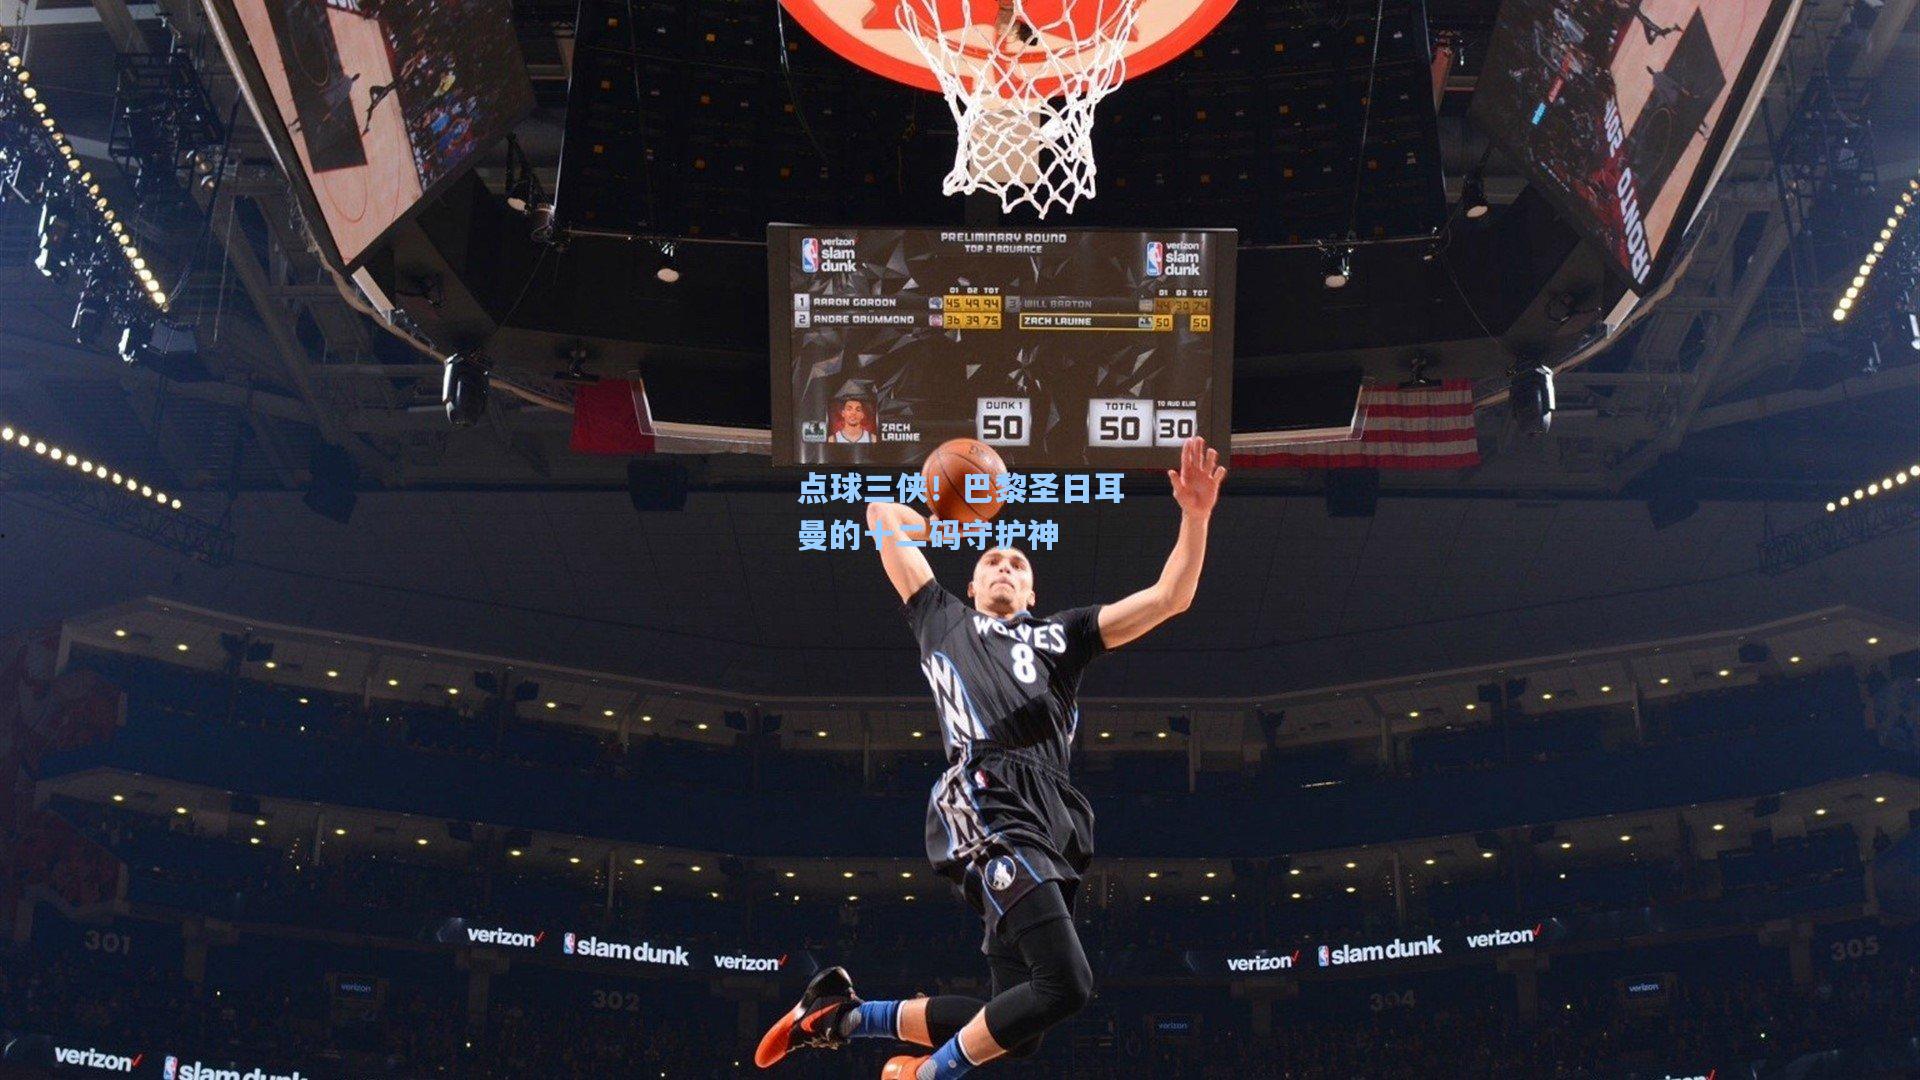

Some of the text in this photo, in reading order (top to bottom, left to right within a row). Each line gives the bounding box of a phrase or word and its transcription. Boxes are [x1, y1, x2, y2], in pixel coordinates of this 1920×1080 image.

[1617, 167, 1651, 285] RONTO
[821, 237, 855, 246] verizon
[940, 232, 1067, 243] PRELIMINARY ROUND
[821, 246, 855, 259] slam
[965, 244, 1043, 254] TOP 2 ADVANCE
[1166, 241, 1199, 250] verizon
[1165, 250, 1199, 263] slam
[821, 259, 857, 272] dunk
[1165, 263, 1200, 276] dunk
[813, 298, 850, 307] AARON
[852, 298, 897, 307] GORDON
[946, 298, 960, 308] 45
[965, 298, 980, 308] 49
[983, 298, 999, 308] 94
[1024, 300, 1048, 308] WILL
[1050, 300, 1092, 309] BARTON
[813, 315, 850, 323] ANDRE
[852, 315, 915, 324] DRUMMOND
[965, 315, 980, 325] 39
[983, 315, 999, 326] 75
[1024, 316, 1208, 328] ZACH LAVINE 50 50
[986, 401, 1015, 410] DUNK
[1105, 402, 1138, 411] TOTAL
[881, 422, 911, 432] ZACH
[983, 415, 1023, 440] 50
[1100, 416, 1140, 441] 50
[1159, 418, 1193, 438] 30
[881, 432, 920, 442] LAVINE
[973, 615, 1067, 654] WOLVES
[1011, 643, 1037, 684] 8
[84, 930, 131, 955] 301
[467, 927, 536, 948] verizon
[1466, 929, 1534, 948] verizon
[577, 936, 690, 966] slam dunk
[1331, 935, 1443, 965] slam dunk
[1830, 935, 1879, 962] 305
[713, 954, 779, 971] verizon
[1227, 955, 1292, 971] verizon
[340, 982, 372, 992] verizon
[592, 989, 640, 1012] 302
[54, 1046, 132, 1072] verizon
[178, 1061, 241, 1080] slam
